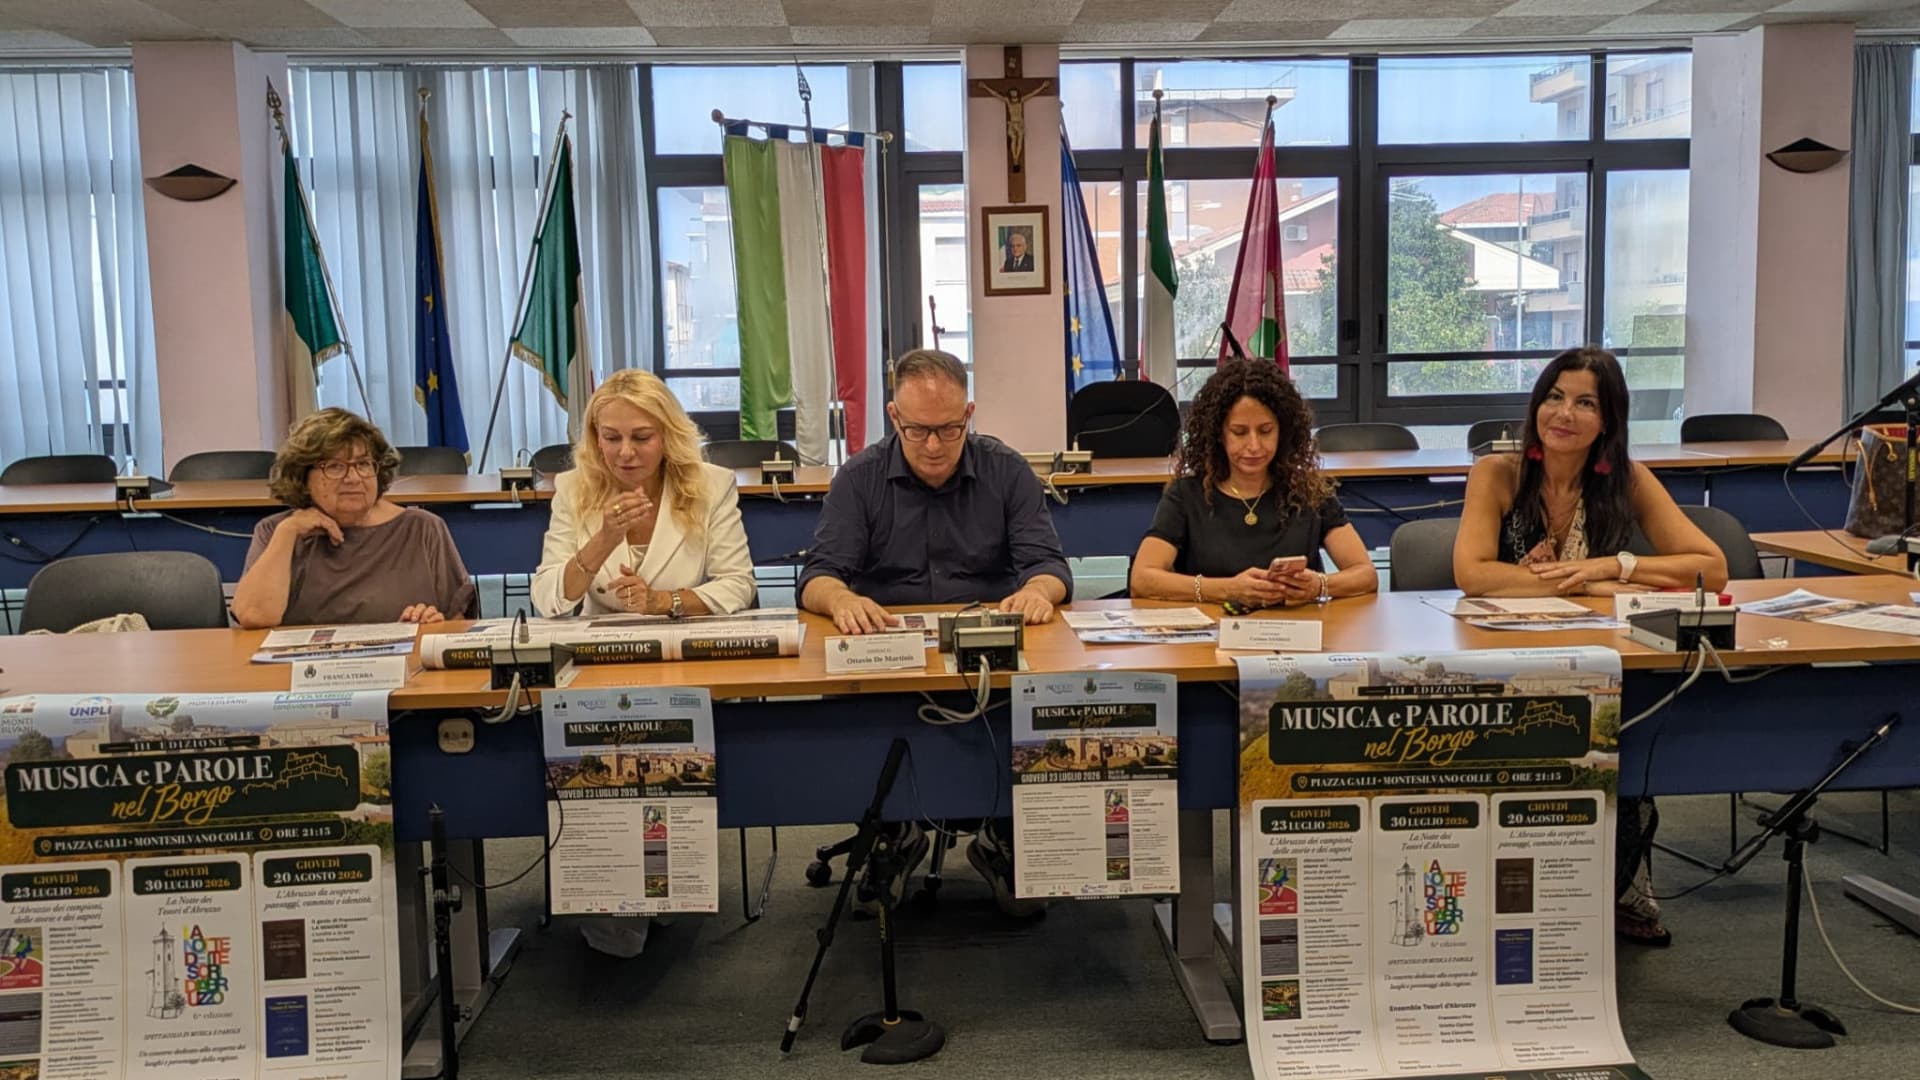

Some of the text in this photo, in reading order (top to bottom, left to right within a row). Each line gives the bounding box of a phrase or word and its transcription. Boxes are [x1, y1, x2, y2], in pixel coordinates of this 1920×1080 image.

[598, 643, 634, 653] LUGLIO
[635, 642, 651, 653] 30
[692, 638, 768, 649] 23 LUGLIO 2026
[450, 650, 475, 659] 2026
[847, 657, 873, 665] Ottavio
[1390, 684, 1472, 695] III EDIZIONE
[69, 705, 112, 718] UNPLI
[1036, 706, 1077, 718] MUSICA
[1084, 705, 1127, 716] PAROLE
[1281, 702, 1513, 730] MUSICA e PAROLE
[569, 722, 610, 735] MUSICA
[619, 721, 663, 732] PAROLE
[134, 738, 226, 751] III EDIZIONE
[1364, 726, 1478, 766] nel Borgo
[17, 755, 273, 792] MUSICA e PAROLE
[1021, 772, 1048, 784] GIOVEDÌ
[1049, 772, 1058, 782] 23
[1058, 771, 1083, 782] LUGLIO
[1310, 771, 1562, 788] PIAZZA GALLI MONTESILVANO COLLE ORE 21:15
[585, 788, 594, 798] 23
[595, 787, 620, 798] LUGLIO
[112, 783, 235, 826] nel Borgo
[1409, 804, 1450, 814] GIOVEDÌ
[1528, 801, 1568, 812] GIOVEDÌ
[1290, 808, 1331, 818] GIOVEDÌ
[1507, 813, 1589, 825] 20 AGOSTO 2026
[1271, 820, 1350, 831] 23 LUGLIO 2026
[1391, 815, 1469, 827] 30 LUGLIO 2026
[55, 826, 332, 853] PIAZZA GALLI MONTESILVANO COLLE ORE 21:15
[296, 857, 340, 870] GIOVEDÌ
[165, 865, 209, 877] GIOVEDÌ
[273, 869, 363, 883] 20 AGOSTO 2026
[33, 872, 79, 884] GIOVEDÌ
[145, 877, 231, 891] 30 LUGLIO 2026
[1424, 871, 1467, 886] NOTTE
[13, 885, 100, 899] 23 LUGLIO 2026
[184, 937, 232, 953] NOTTE
